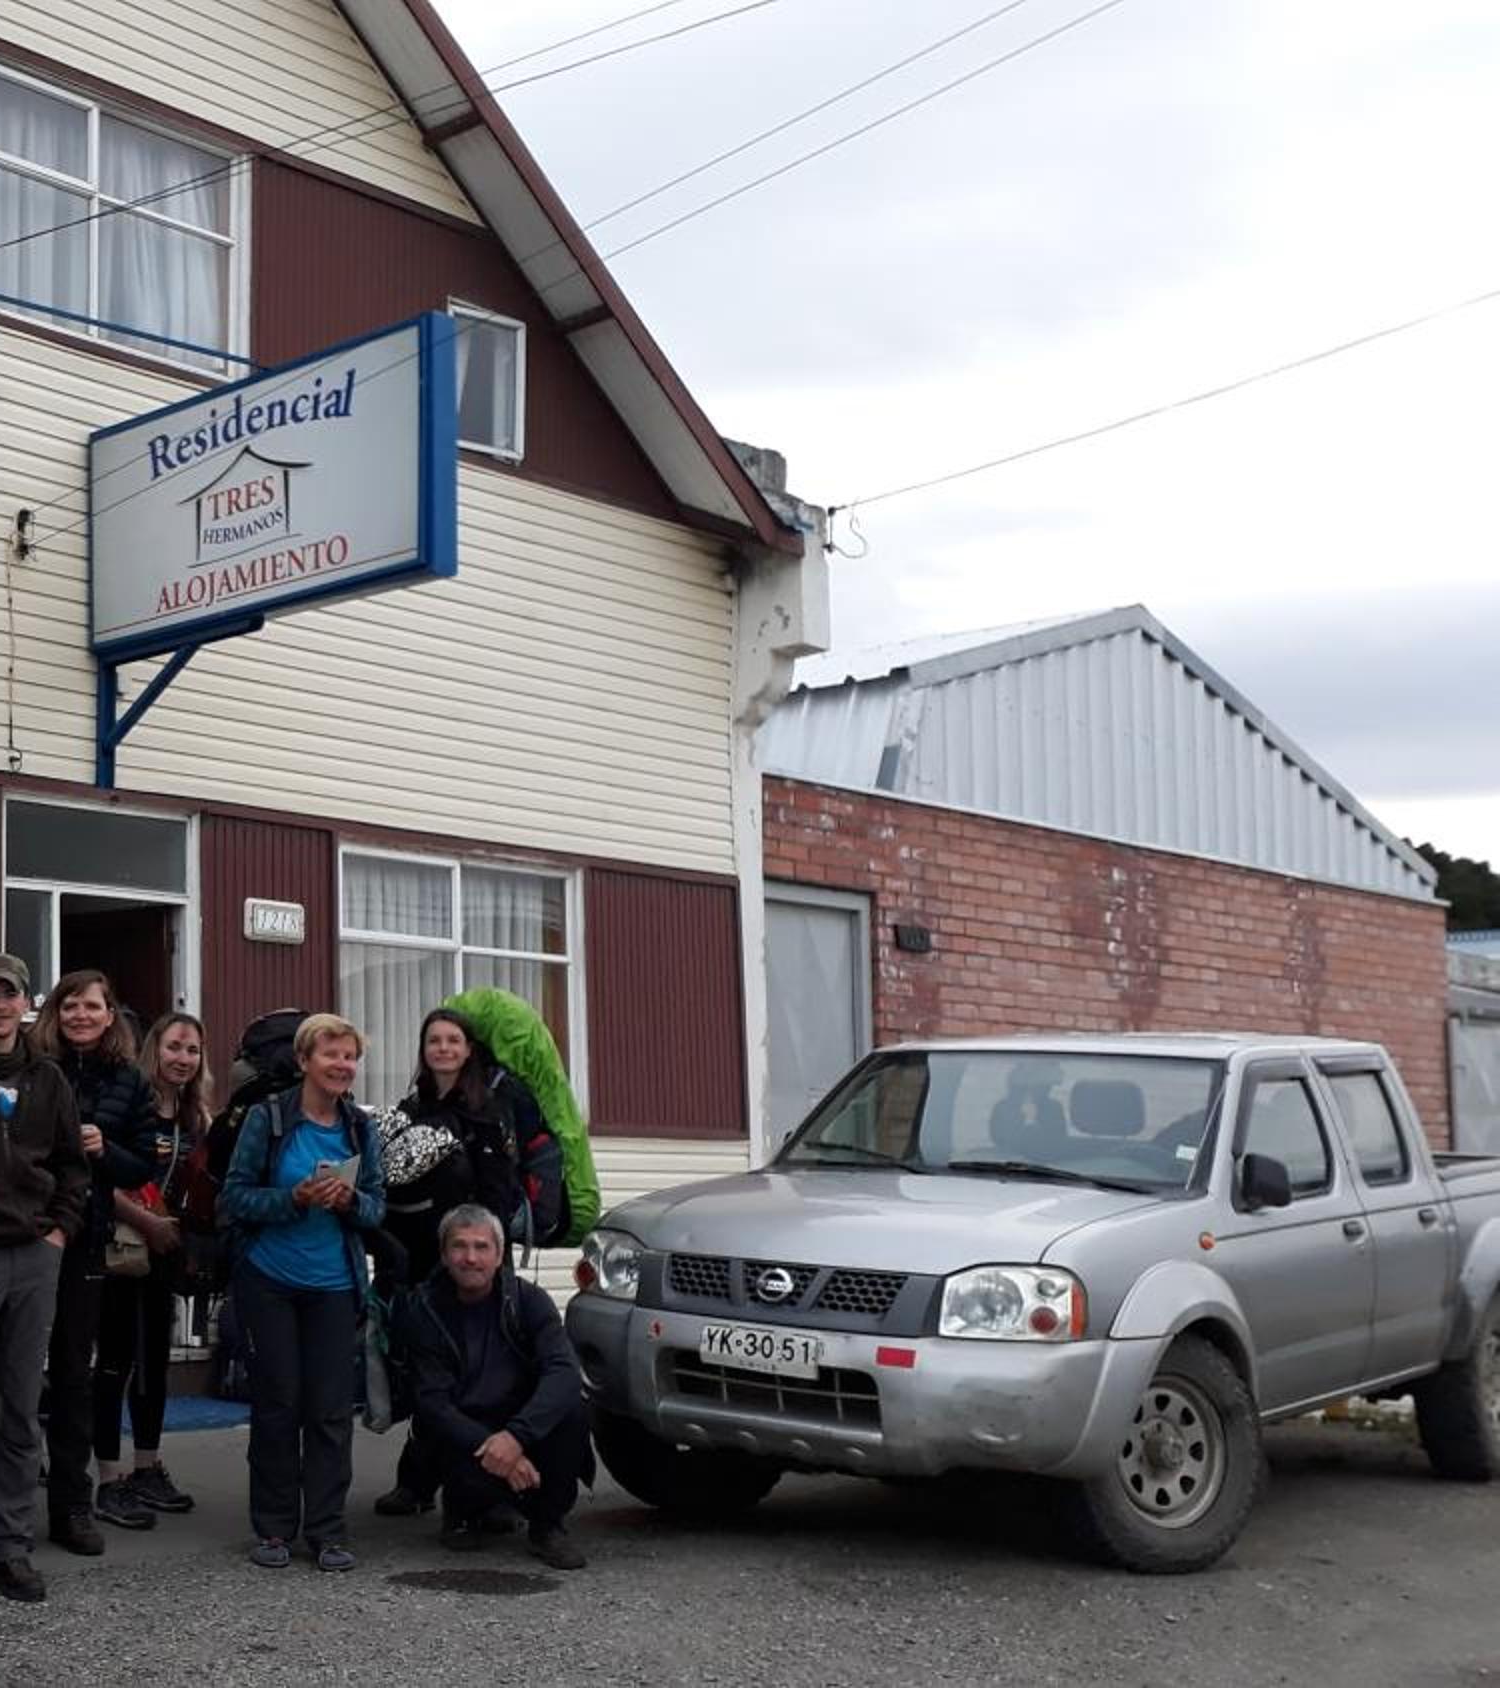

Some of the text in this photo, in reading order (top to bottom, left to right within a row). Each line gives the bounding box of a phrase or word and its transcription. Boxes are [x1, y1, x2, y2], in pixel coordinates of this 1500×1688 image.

[149, 368, 355, 481] Residencial
[203, 508, 284, 545] HERMANOS
[208, 476, 275, 521] TRES
[156, 535, 349, 613] ALOJAMIENTO
